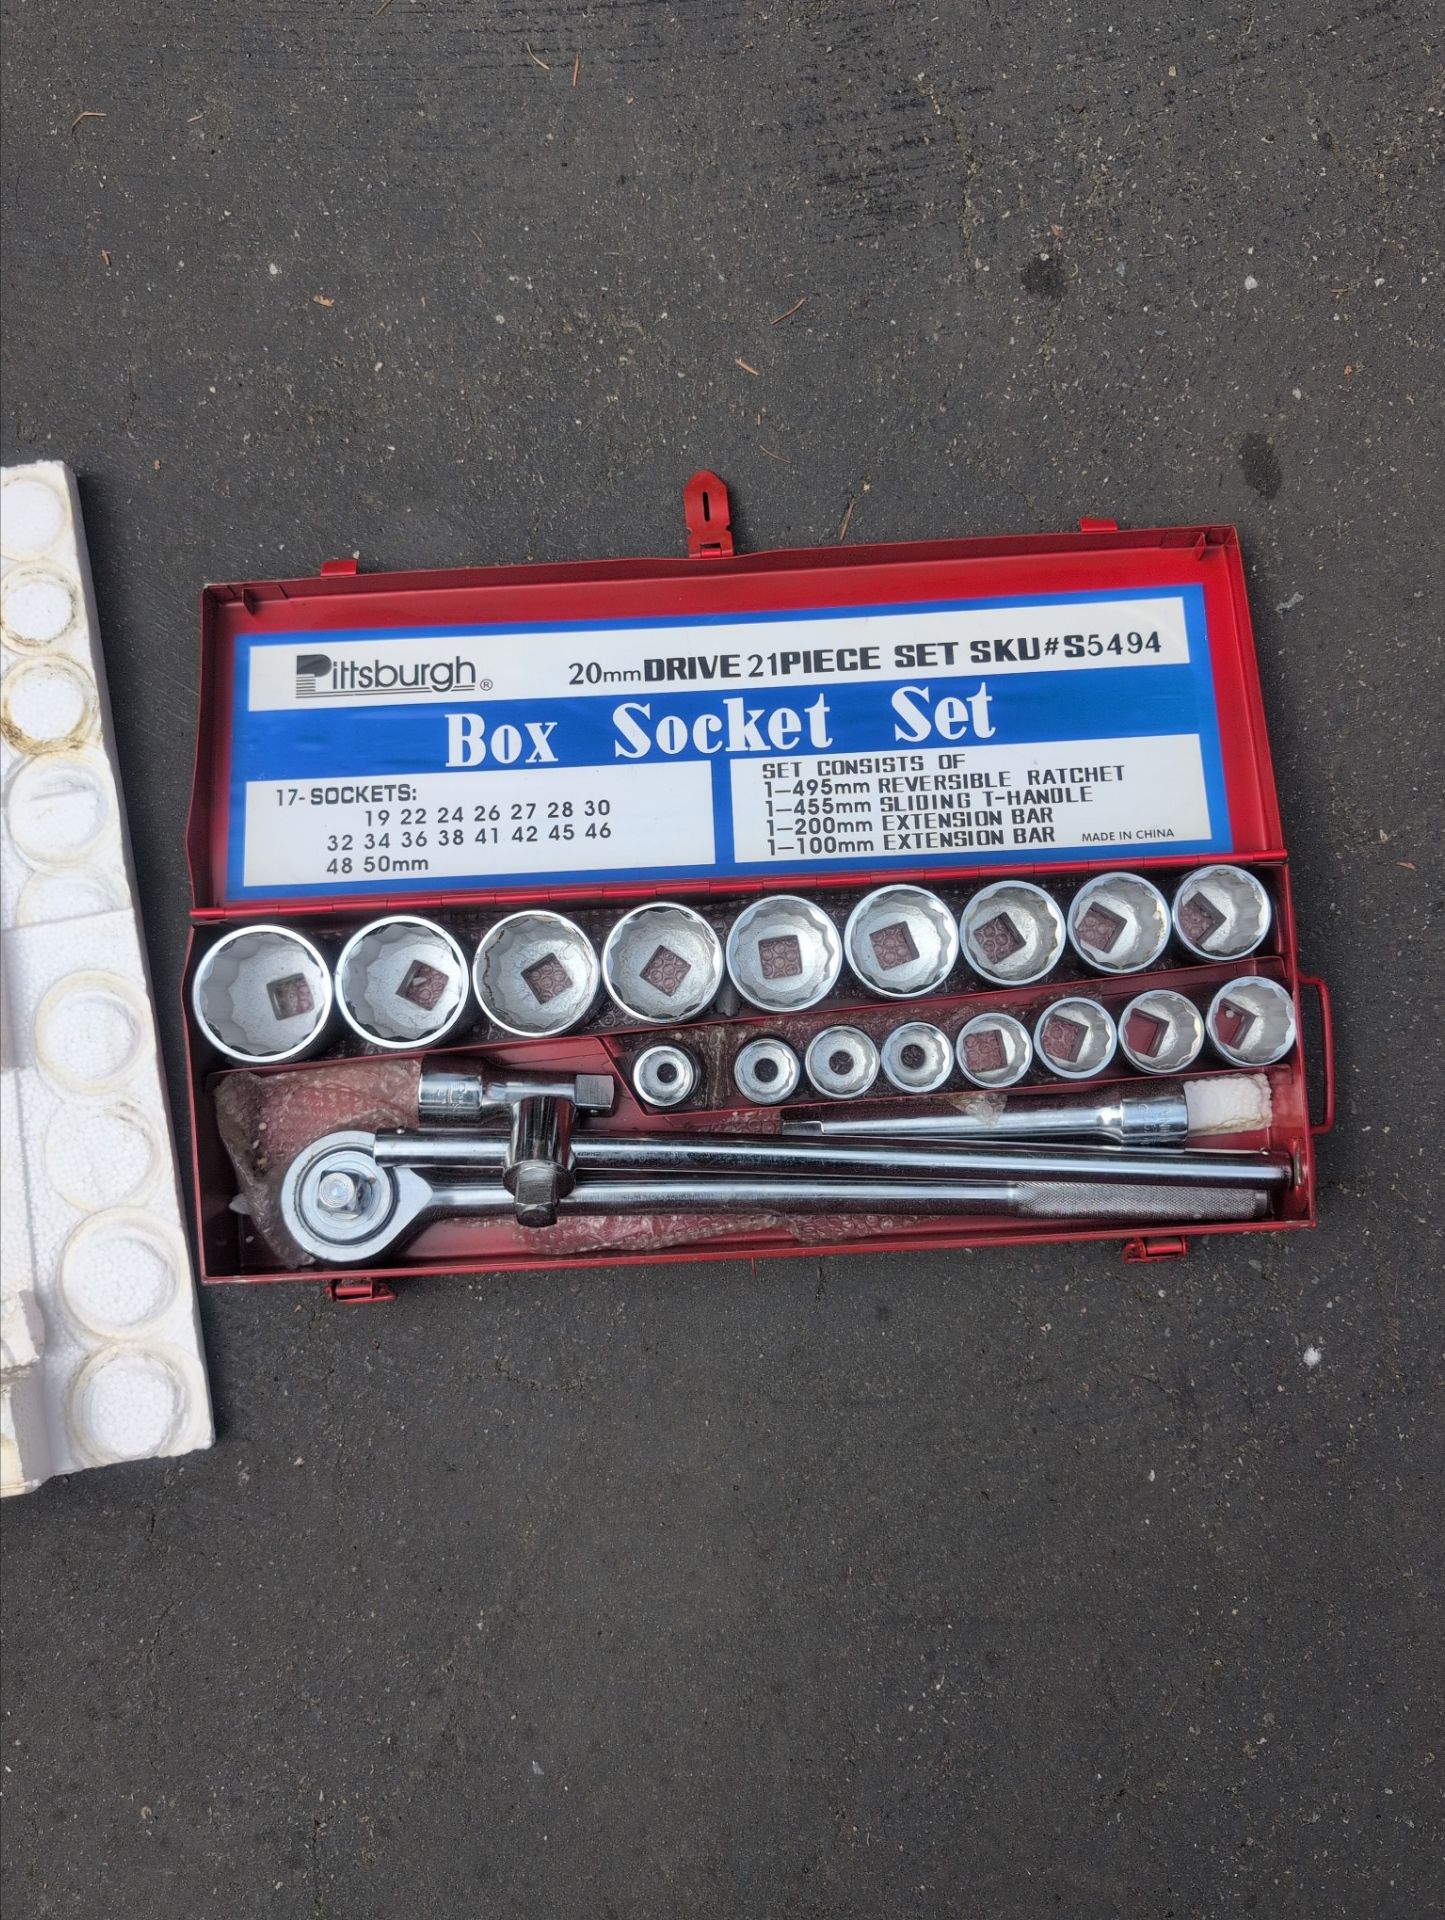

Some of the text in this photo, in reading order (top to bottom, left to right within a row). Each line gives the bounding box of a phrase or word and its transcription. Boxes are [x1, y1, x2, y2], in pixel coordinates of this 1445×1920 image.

[894, 641, 959, 669] SET
[296, 654, 476, 698] Pittsburgh
[445, 681, 996, 768] Box Socket Set
[762, 753, 966, 778] SET CONSISTS OF
[878, 771, 1011, 794] REVERSIBLE
[1027, 765, 1125, 786] RATCHET
[310, 783, 417, 805] SOCKETS:
[880, 792, 971, 813] SLIDING
[982, 786, 1093, 808] T-HANDLE
[365, 799, 610, 826] 19 22 24 26 27 28 30
[882, 810, 1002, 832] EXTENSION
[1011, 807, 1054, 825] BAR
[327, 822, 612, 851] 32 34 36 38 41 42 45 46
[883, 829, 1004, 851] EXTENSION
[1013, 826, 1056, 845] BAR
[1081, 828, 1175, 843] MADE IN CHINA
[326, 855, 429, 874] 48 50mm
